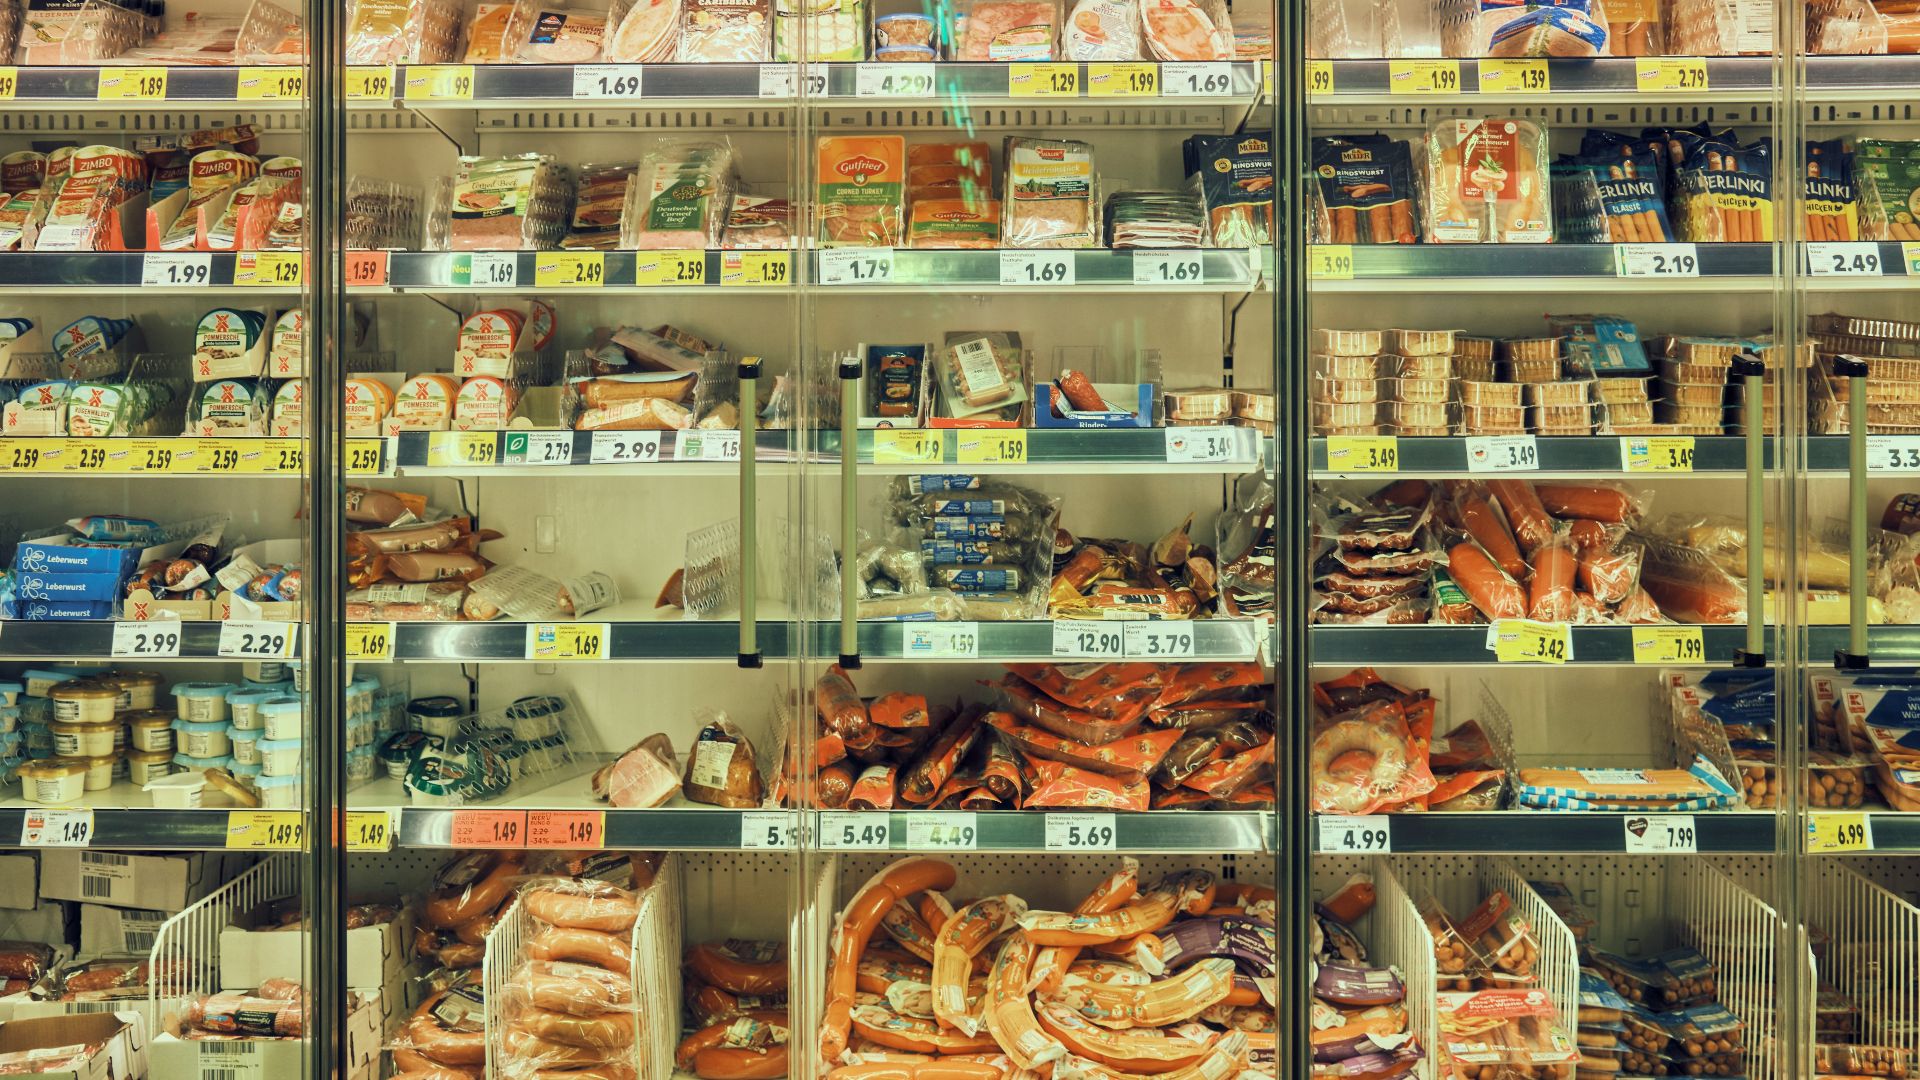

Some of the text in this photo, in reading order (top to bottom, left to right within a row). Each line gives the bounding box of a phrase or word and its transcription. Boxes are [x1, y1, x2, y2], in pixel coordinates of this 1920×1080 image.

[139, 77, 163, 97] 1.89
[278, 77, 302, 97] 1.99
[364, 77, 387, 96] 1.99
[598, 76, 639, 95] 1.69
[882, 75, 927, 94] 4.29
[1051, 72, 1075, 92] 1.29
[1129, 72, 1154, 92] 1.99
[1188, 74, 1229, 93] 1.69
[1431, 70, 1456, 90] 1.99
[1521, 69, 1545, 89] 1.39
[1678, 69, 1704, 88] 2.79
[7, 164, 38, 178] ZIMBO
[80, 157, 113, 172] ZIMBO
[198, 161, 232, 175] ZIMBO
[840, 159, 883, 175] Gutfried
[1232, 161, 1273, 170] RINDSWUR
[1336, 168, 1385, 177] RINDSWURST
[836, 187, 884, 196] CORNED TURKEY
[1598, 181, 1655, 200] ERLINKI
[1805, 181, 1850, 199] RLINKI
[656, 205, 699, 213] Deutsches
[1612, 202, 1641, 214] CLASSIC
[1717, 197, 1748, 207] CHICKEN
[1806, 204, 1833, 213] HICKEN
[661, 210, 693, 218] Corned
[935, 212, 977, 221] Gutfried
[275, 262, 299, 282] 1.29
[353, 261, 377, 280] 1.59
[452, 264, 471, 274] Neu
[489, 263, 513, 282] 1.69
[576, 262, 602, 282] 2.49
[677, 261, 703, 280] 2.59
[762, 262, 786, 281] 1.39
[849, 259, 890, 280] 1.79
[1025, 263, 1067, 281] 1.69
[1159, 262, 1201, 280] 1.69
[1324, 256, 1350, 273] 3.99
[1652, 255, 1695, 273] 2.19
[1832, 254, 1878, 272] 2.49
[167, 264, 208, 283] 1.99
[203, 333, 240, 342] POMMERSCHE
[467, 334, 505, 342] POMMERSCHE
[75, 406, 110, 419] RÜGENWALDER
[208, 404, 245, 412] POMMERSCHE
[403, 401, 440, 409] POMMERSCHE
[463, 402, 500, 410] POMMERSCHE
[468, 443, 494, 462] 2.59
[544, 442, 570, 461] 2.79
[613, 442, 657, 459] 2.99
[998, 440, 1023, 460] 1.59
[1207, 437, 1233, 457] 3.49
[1508, 446, 1535, 466] 3.49
[12, 448, 39, 468] 2.59
[79, 448, 106, 468] 2.59
[146, 449, 172, 469] 2.59
[212, 449, 239, 469] 2.59
[278, 450, 302, 469] 2.59
[352, 449, 377, 469] 2.59
[1369, 448, 1395, 468] 3.49
[47, 554, 88, 565] Leberwurst
[46, 582, 86, 592] Leberwurst
[50, 607, 91, 617] Leberwurst
[134, 633, 178, 653] 2.99
[240, 633, 284, 655] 2.29
[361, 635, 385, 654] 1.69
[574, 635, 599, 655] 1.69
[950, 634, 975, 654] 1.59
[1077, 633, 1120, 653] 12.90
[1147, 634, 1191, 654] 3.79
[1537, 636, 1565, 659] 3.42
[1674, 638, 1701, 658] 7.99
[63, 822, 88, 842] 1.49
[268, 824, 292, 844] 1.49
[360, 824, 384, 844] 1.49
[454, 836, 474, 844] -34%
[493, 821, 517, 841] 1.49
[569, 821, 592, 842] 1.49
[843, 825, 887, 845] 5.49
[930, 826, 974, 846] 4.49
[1068, 826, 1112, 846] 5.69
[1343, 829, 1387, 849] 4.99
[1667, 827, 1693, 848] 7.99
[1837, 823, 1864, 845] 6.99
[530, 837, 550, 845] -34%
